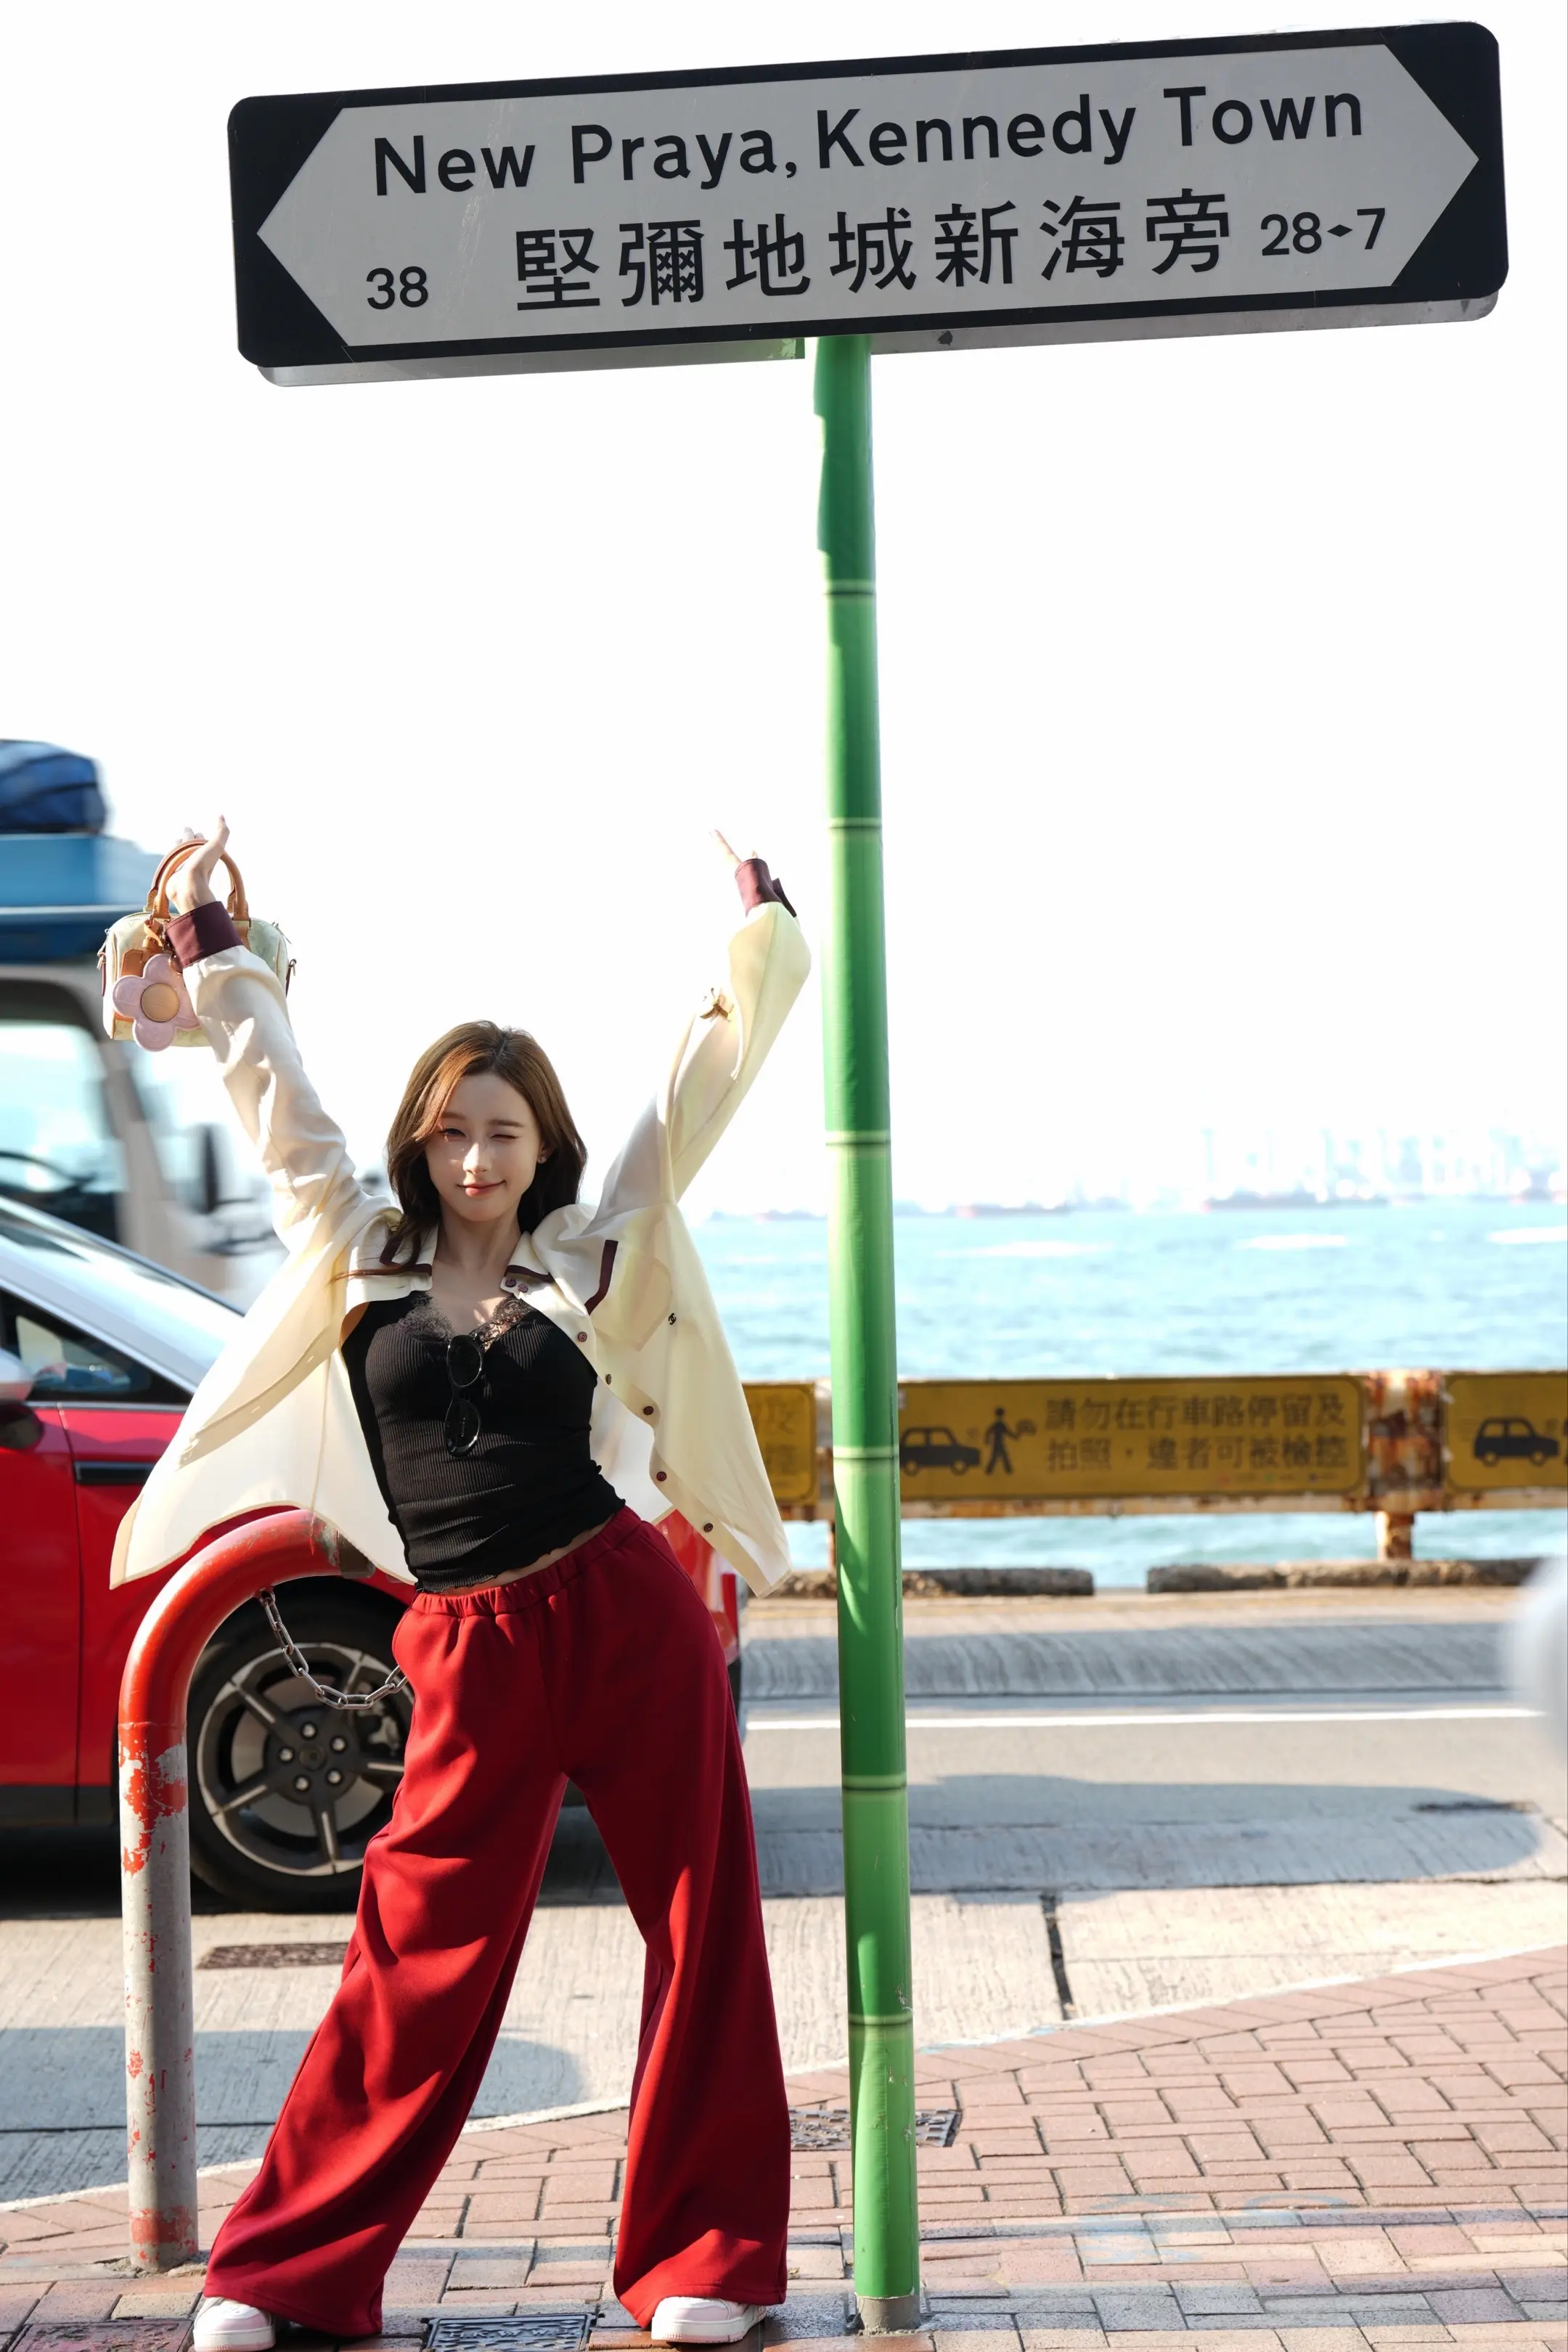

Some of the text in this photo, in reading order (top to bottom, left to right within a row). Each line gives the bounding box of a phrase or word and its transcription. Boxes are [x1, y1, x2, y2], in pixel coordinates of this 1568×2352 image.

[374, 86, 1362, 196] New Praya, Kennedy Town
[366, 266, 428, 310] 38
[515, 187, 1230, 312] 堅彌地城新海旁
